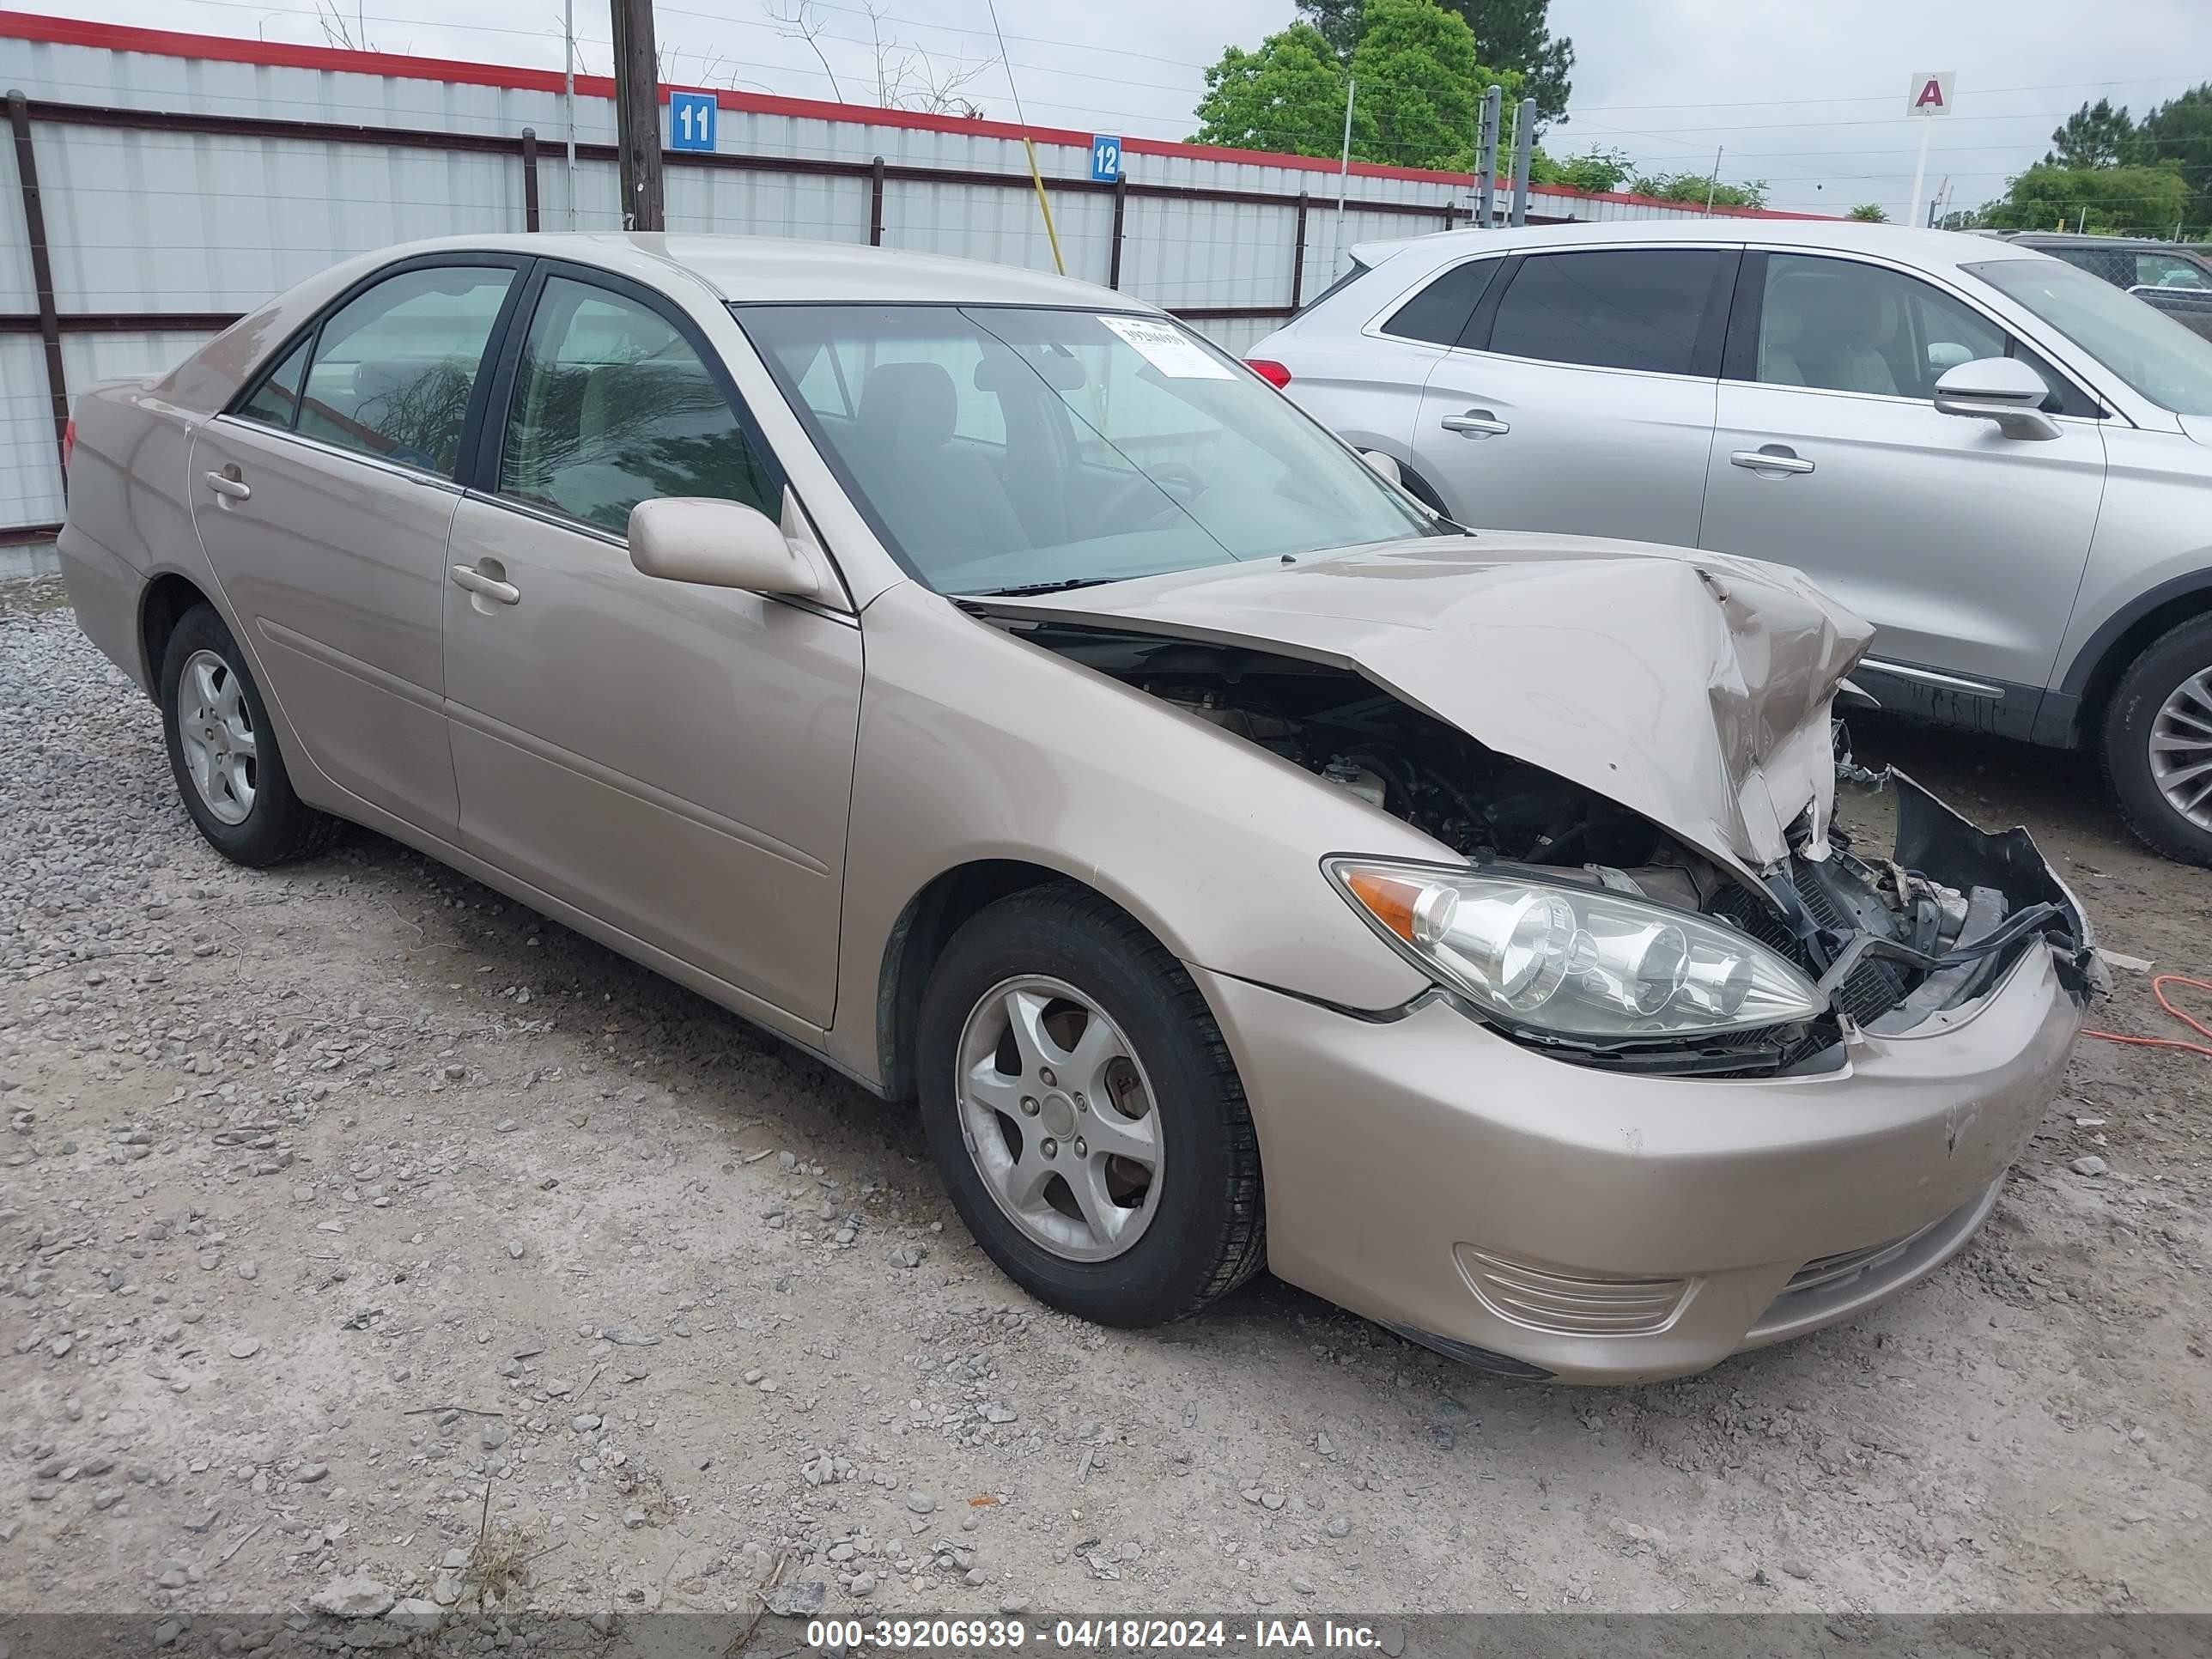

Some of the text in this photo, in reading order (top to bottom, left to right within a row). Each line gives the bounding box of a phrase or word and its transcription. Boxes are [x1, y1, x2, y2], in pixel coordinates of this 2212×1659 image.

[1915, 80, 1944, 107] A
[680, 104, 708, 142] 11
[1097, 144, 1116, 174] 12
